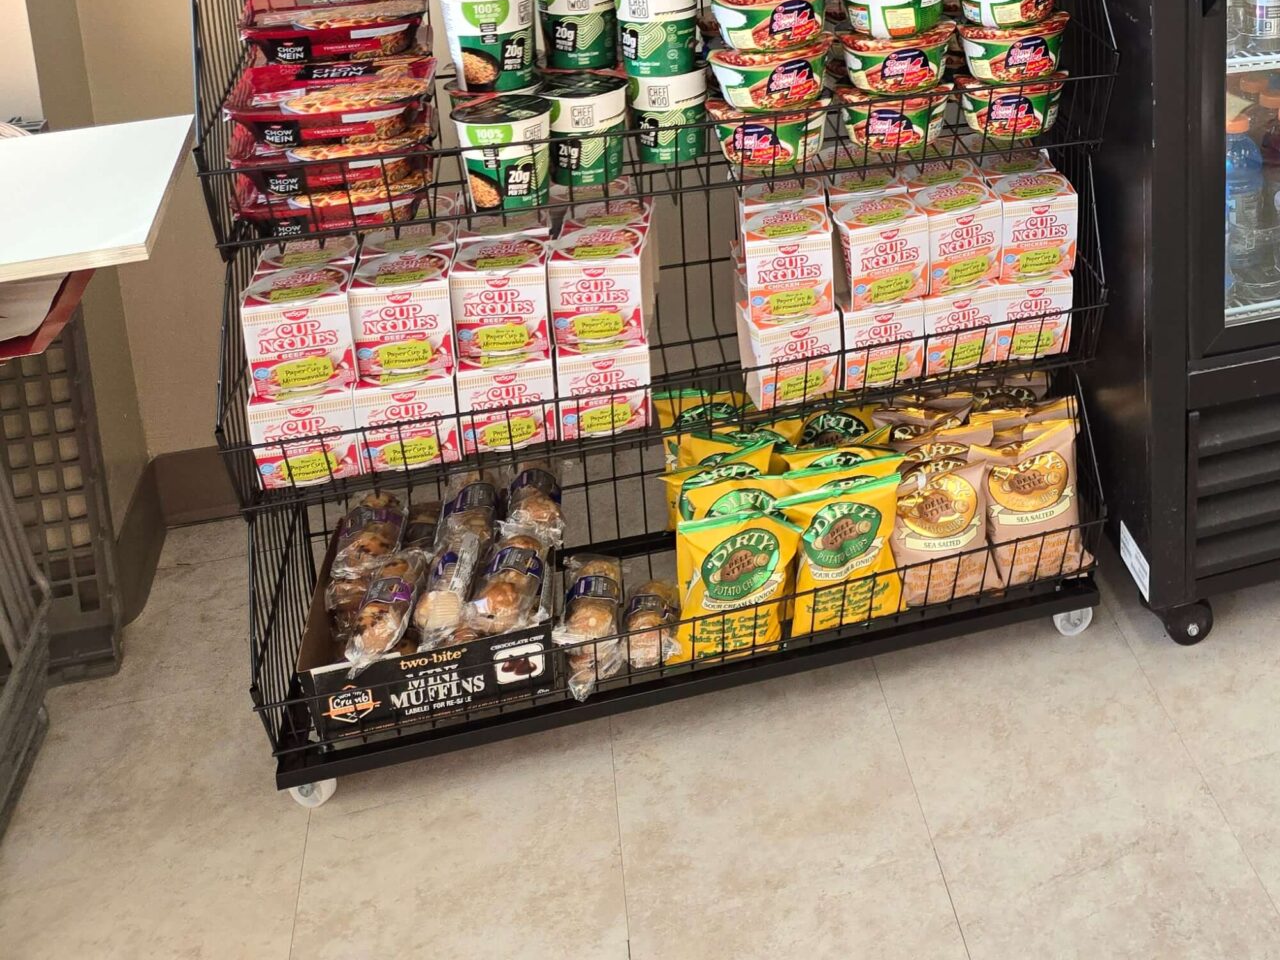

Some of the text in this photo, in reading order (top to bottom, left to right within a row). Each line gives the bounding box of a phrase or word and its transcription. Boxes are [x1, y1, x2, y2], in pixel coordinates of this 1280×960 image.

[473, 4, 501, 14] 100%
[569, 0, 587, 9] WOO
[630, 7, 647, 16] WOO
[555, 26, 575, 39] 20g
[622, 33, 637, 48] 20g
[277, 52, 304, 60] MEIN
[505, 45, 523, 58] 20g
[1011, 46, 1033, 57] Bowl
[312, 66, 368, 74] CHOW
[649, 88, 666, 96] CHEF
[650, 97, 668, 106] WOO
[572, 108, 592, 117] CHEF
[572, 117, 593, 126] WOO
[264, 129, 293, 137] CHOW
[475, 128, 504, 139] 100%
[509, 170, 530, 184] 20g
[270, 184, 298, 192] MEIN
[1025, 215, 1057, 229] CUP
[951, 224, 983, 241] CUP
[1012, 225, 1067, 242] NOODLES
[874, 239, 907, 256] CUP
[939, 231, 994, 256] NOODLES
[772, 255, 808, 270] CUP
[861, 246, 919, 272] NOODLES
[758, 265, 821, 284] NOODLES
[575, 279, 615, 292] CUP
[479, 290, 520, 304] CUP
[560, 290, 629, 306] NOODLES
[380, 305, 422, 320] CUP
[464, 301, 535, 317] NOODLES
[1020, 298, 1051, 312] CUP
[948, 308, 979, 324] CUP
[276, 321, 320, 337] CUP
[363, 315, 438, 336] NOODLES
[869, 323, 902, 339] CUP
[260, 331, 338, 354] NOODLES
[784, 337, 818, 355] CUP
[586, 369, 624, 386] CUP
[487, 384, 527, 401] CUP
[384, 402, 427, 419] CUP
[281, 416, 325, 435] CUP
[1017, 473, 1037, 485] DELI
[923, 503, 950, 518] STYLE
[925, 497, 945, 510] DELI
[1030, 510, 1055, 521] SALTED
[938, 539, 961, 548] SALTED
[817, 539, 868, 564] POTATO CHIPS
[729, 553, 749, 569] DELI
[714, 584, 741, 596] POTATO
[490, 634, 544, 651] CHOCOLATE CHIP
[390, 675, 485, 709] MUFFINS
